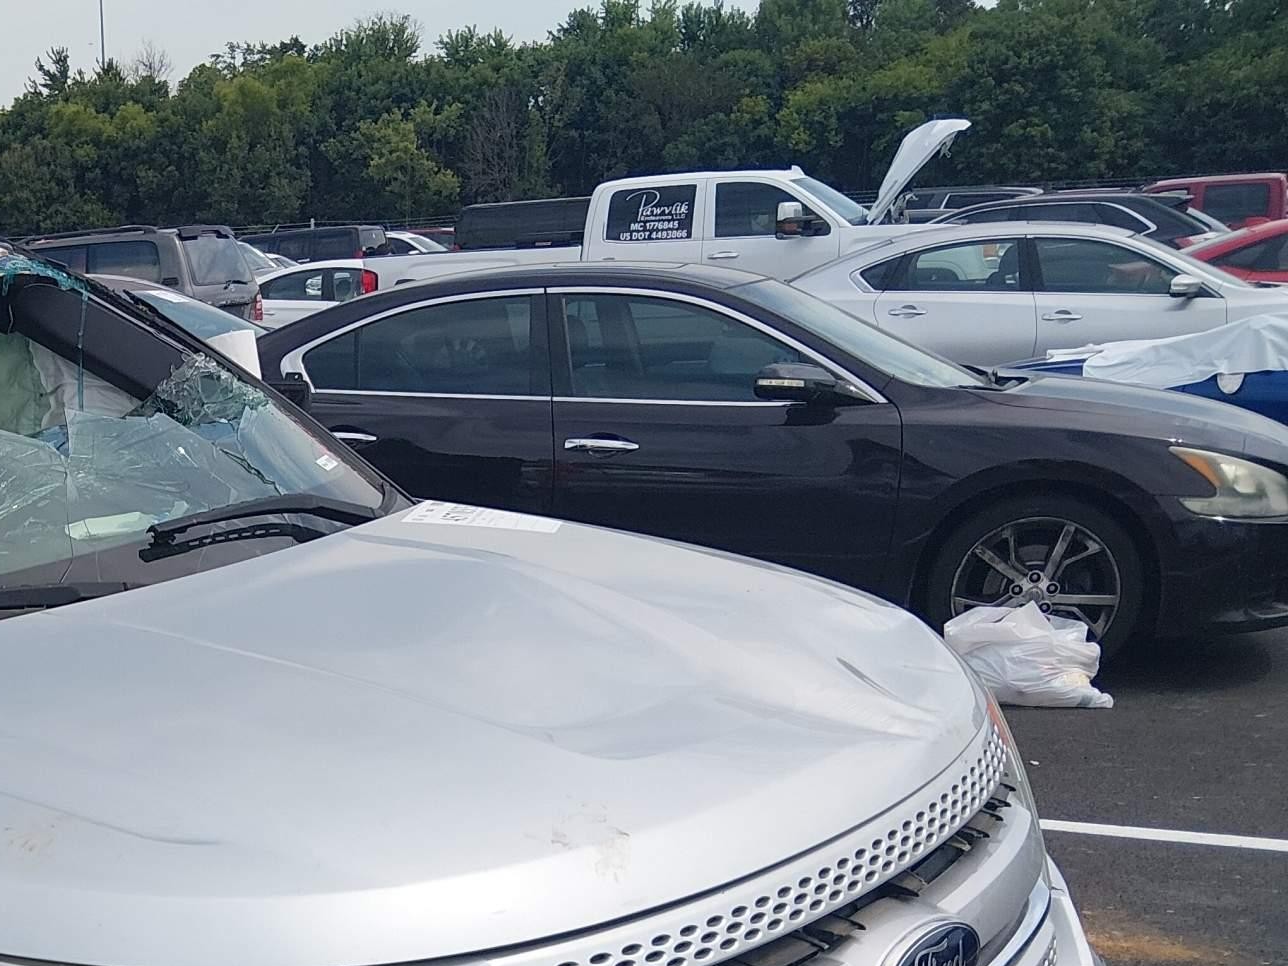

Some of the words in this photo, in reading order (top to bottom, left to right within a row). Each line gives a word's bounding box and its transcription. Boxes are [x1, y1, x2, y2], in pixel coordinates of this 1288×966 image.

[630, 222, 644, 231] MC
[620, 232, 631, 241] US
[632, 231, 650, 240] DOT
